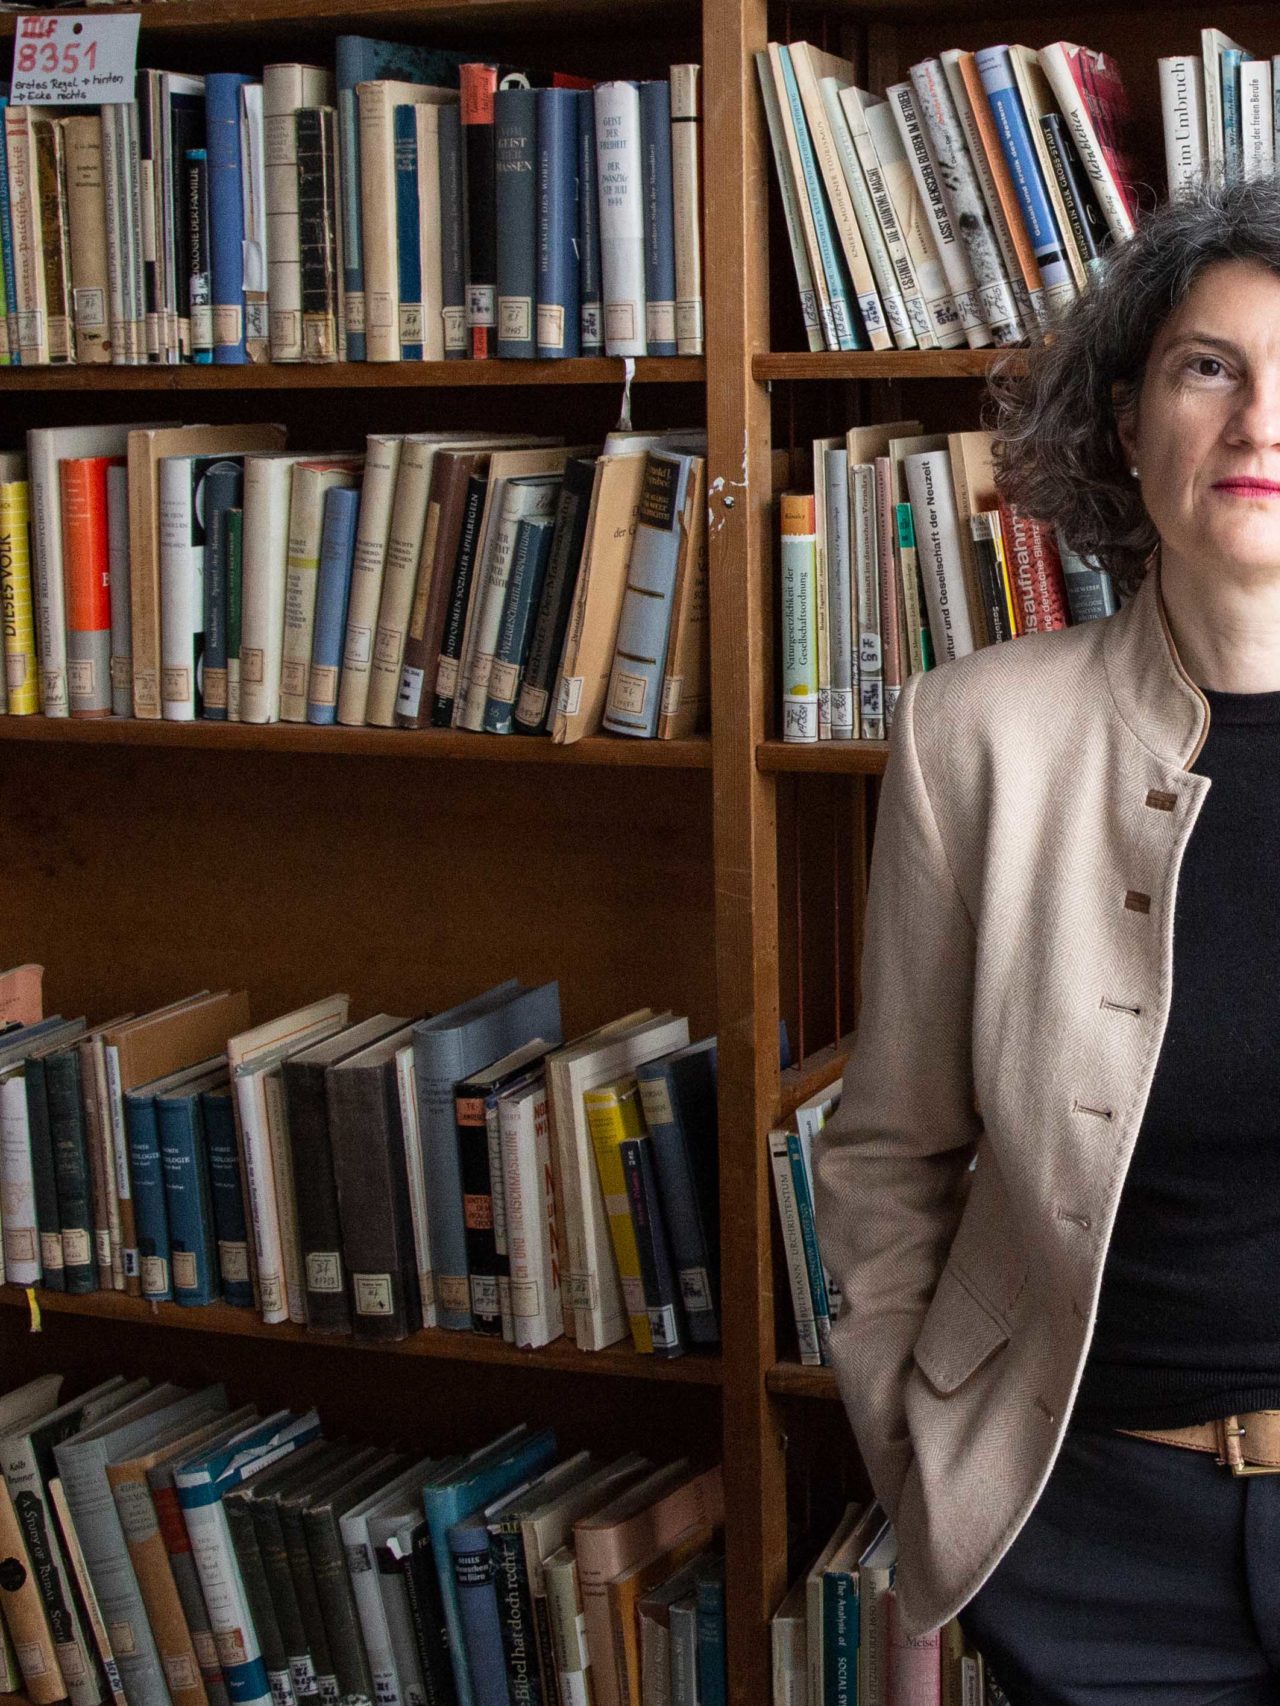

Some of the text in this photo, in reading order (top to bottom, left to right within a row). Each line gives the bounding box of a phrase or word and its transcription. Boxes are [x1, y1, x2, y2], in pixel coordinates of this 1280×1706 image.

[17, 41, 97, 75] 8351
[28, 92, 51, 100] Ecke
[603, 117, 621, 126] GEIST
[1170, 62, 1190, 139] Umbruch
[1249, 78, 1260, 139] der freien Berufe
[814, 119, 850, 223] MODERNER TOURISMUS
[896, 90, 956, 244] LASST SIE MENSCHEN BLEIBEN IM BETRIEB
[996, 100, 1041, 236] Gestalt und Kritik des Westens
[1044, 127, 1067, 187] GROSS-STADT
[1067, 108, 1105, 184] Metabletica
[1175, 144, 1192, 165] im
[190, 167, 199, 231] DER FAMILIE
[540, 193, 548, 212] DES
[865, 165, 900, 243] DIE ANONYME MACHT
[1063, 188, 1074, 207] DER
[1069, 208, 1077, 219] IN
[920, 460, 935, 505] Neuzeit
[454, 492, 479, 598] SOZIALER SPIELREGELN
[927, 508, 938, 527] der
[0, 532, 16, 637] DIESES VOLK
[930, 532, 949, 605] Gesellschaft
[1029, 523, 1050, 612] deutsche Bilanz
[785, 567, 797, 670] Naturgesetzlichkeit der
[796, 571, 810, 665] Gesellschaftsordnung
[939, 607, 951, 629] und
[779, 1174, 799, 1255] URCHRISTENTUM
[512, 1237, 526, 1259] UND
[20, 1497, 32, 1507] A
[500, 1549, 529, 1700] Bibel hat doch recht
[836, 1580, 846, 1690] The Analysis of SOCIAL
[906, 1635, 938, 1647] Meisel
